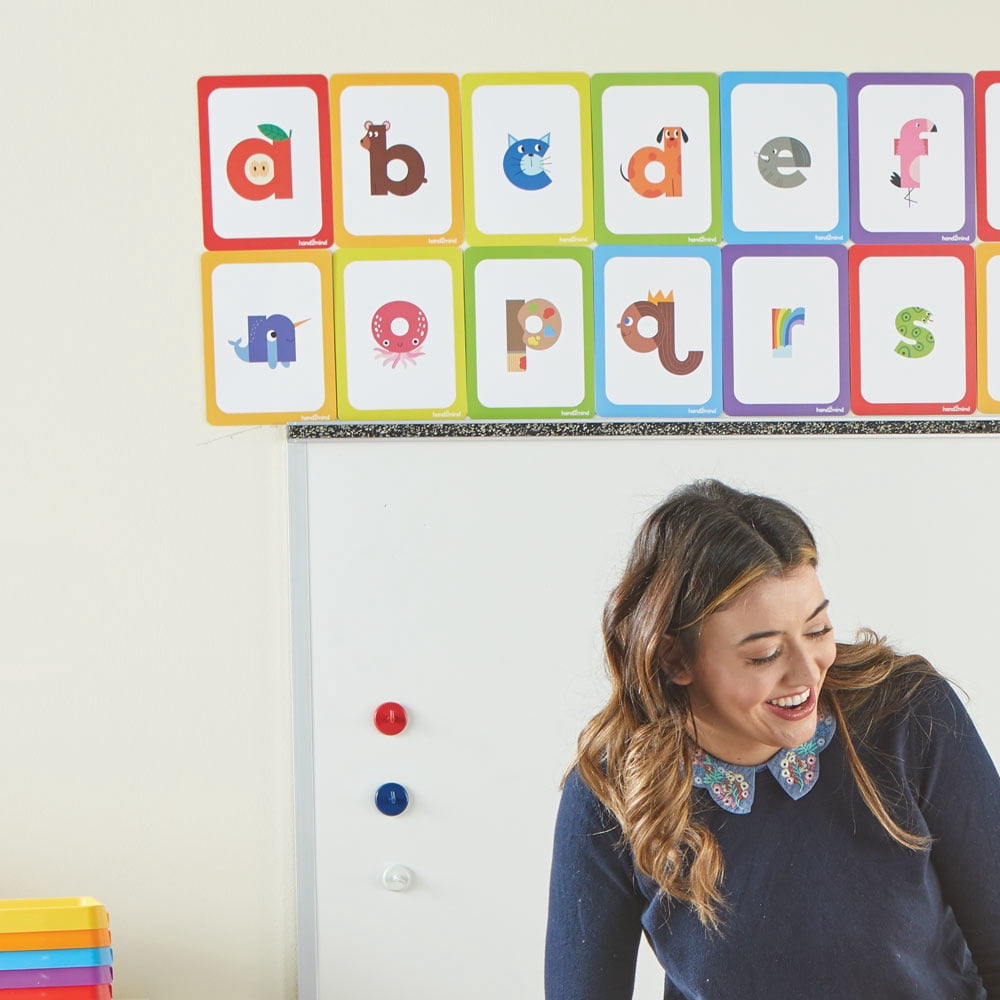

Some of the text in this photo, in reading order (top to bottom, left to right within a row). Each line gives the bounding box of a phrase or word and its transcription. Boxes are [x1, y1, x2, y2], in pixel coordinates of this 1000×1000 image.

[227, 137, 293, 201] a
[366, 124, 428, 197] b
[503, 134, 553, 191] c
[625, 126, 686, 199] d
[757, 136, 812, 189] e
[892, 118, 937, 189] f
[247, 313, 298, 363] n
[371, 300, 429, 354] o
[505, 298, 562, 372] p
[771, 307, 806, 358] r
[893, 306, 935, 359] s
